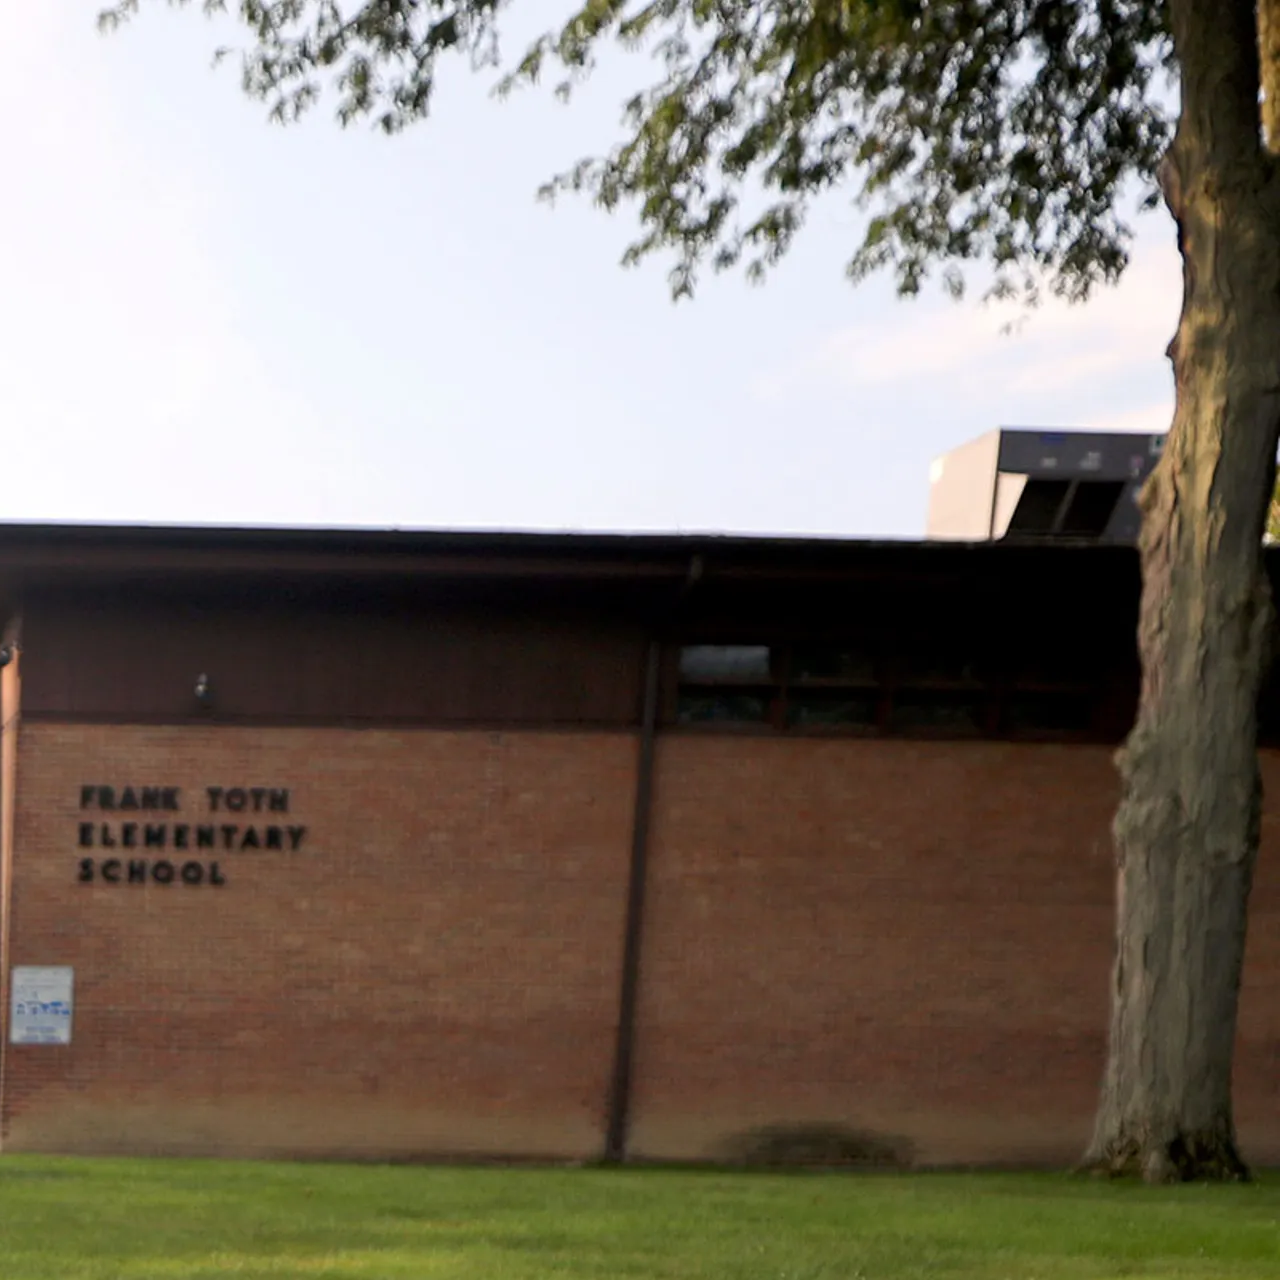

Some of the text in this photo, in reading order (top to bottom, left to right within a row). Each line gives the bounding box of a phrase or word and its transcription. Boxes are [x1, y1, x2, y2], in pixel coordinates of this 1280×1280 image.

[80, 785, 289, 813] FRANK TOTH
[78, 822, 307, 851] ELEMENTARY
[78, 858, 225, 886] SCHOOL
